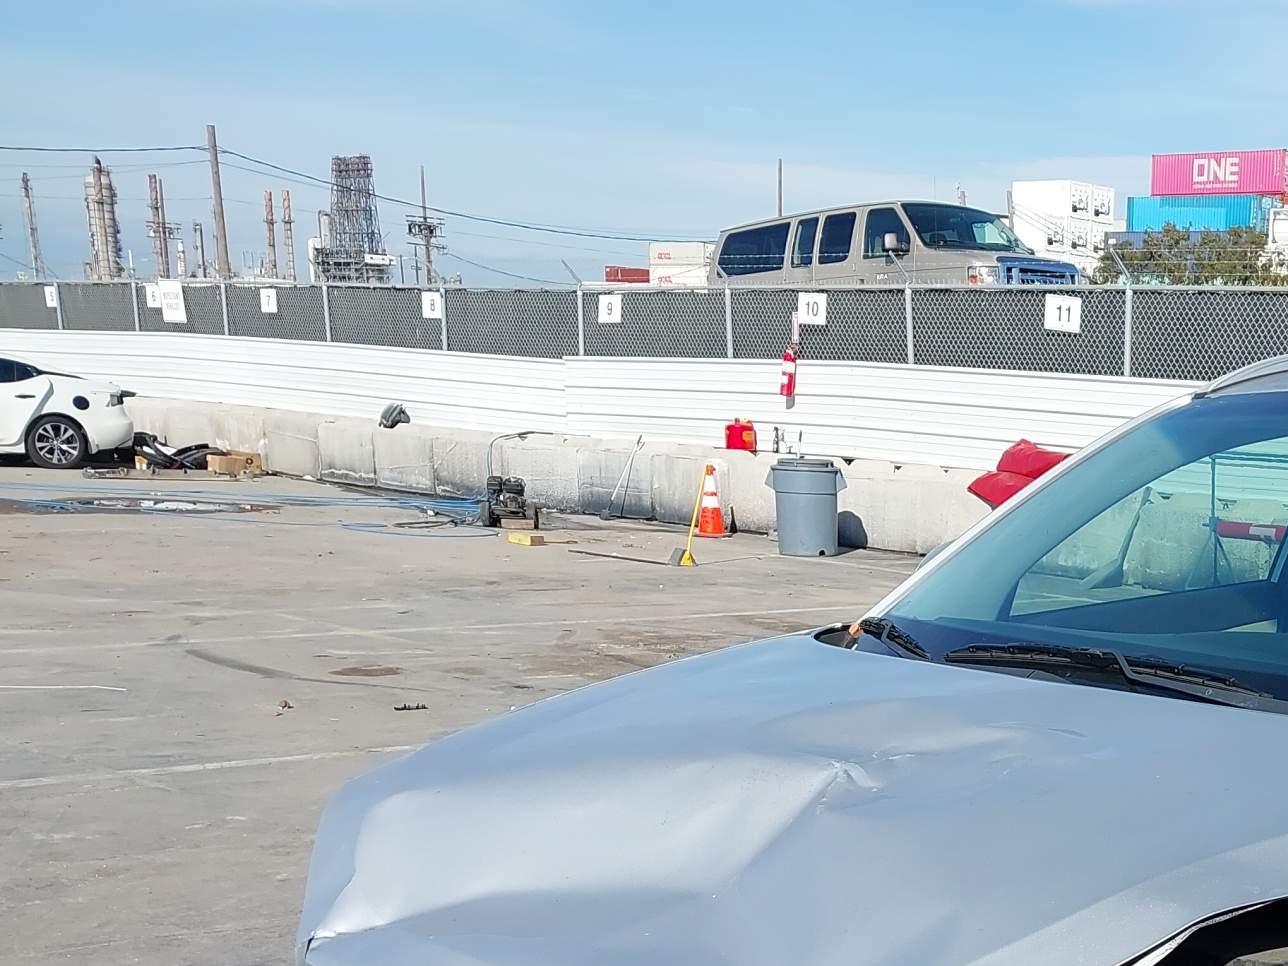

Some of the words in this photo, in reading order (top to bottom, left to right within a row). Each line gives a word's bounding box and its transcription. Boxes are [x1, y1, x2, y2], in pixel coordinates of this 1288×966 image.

[1193, 157, 1240, 182] ONE
[151, 291, 156, 302] 6
[266, 295, 271, 307] 7
[430, 299, 436, 312] 8
[606, 301, 613, 316] 9
[805, 300, 819, 317] 10
[1056, 304, 1071, 322] 11
